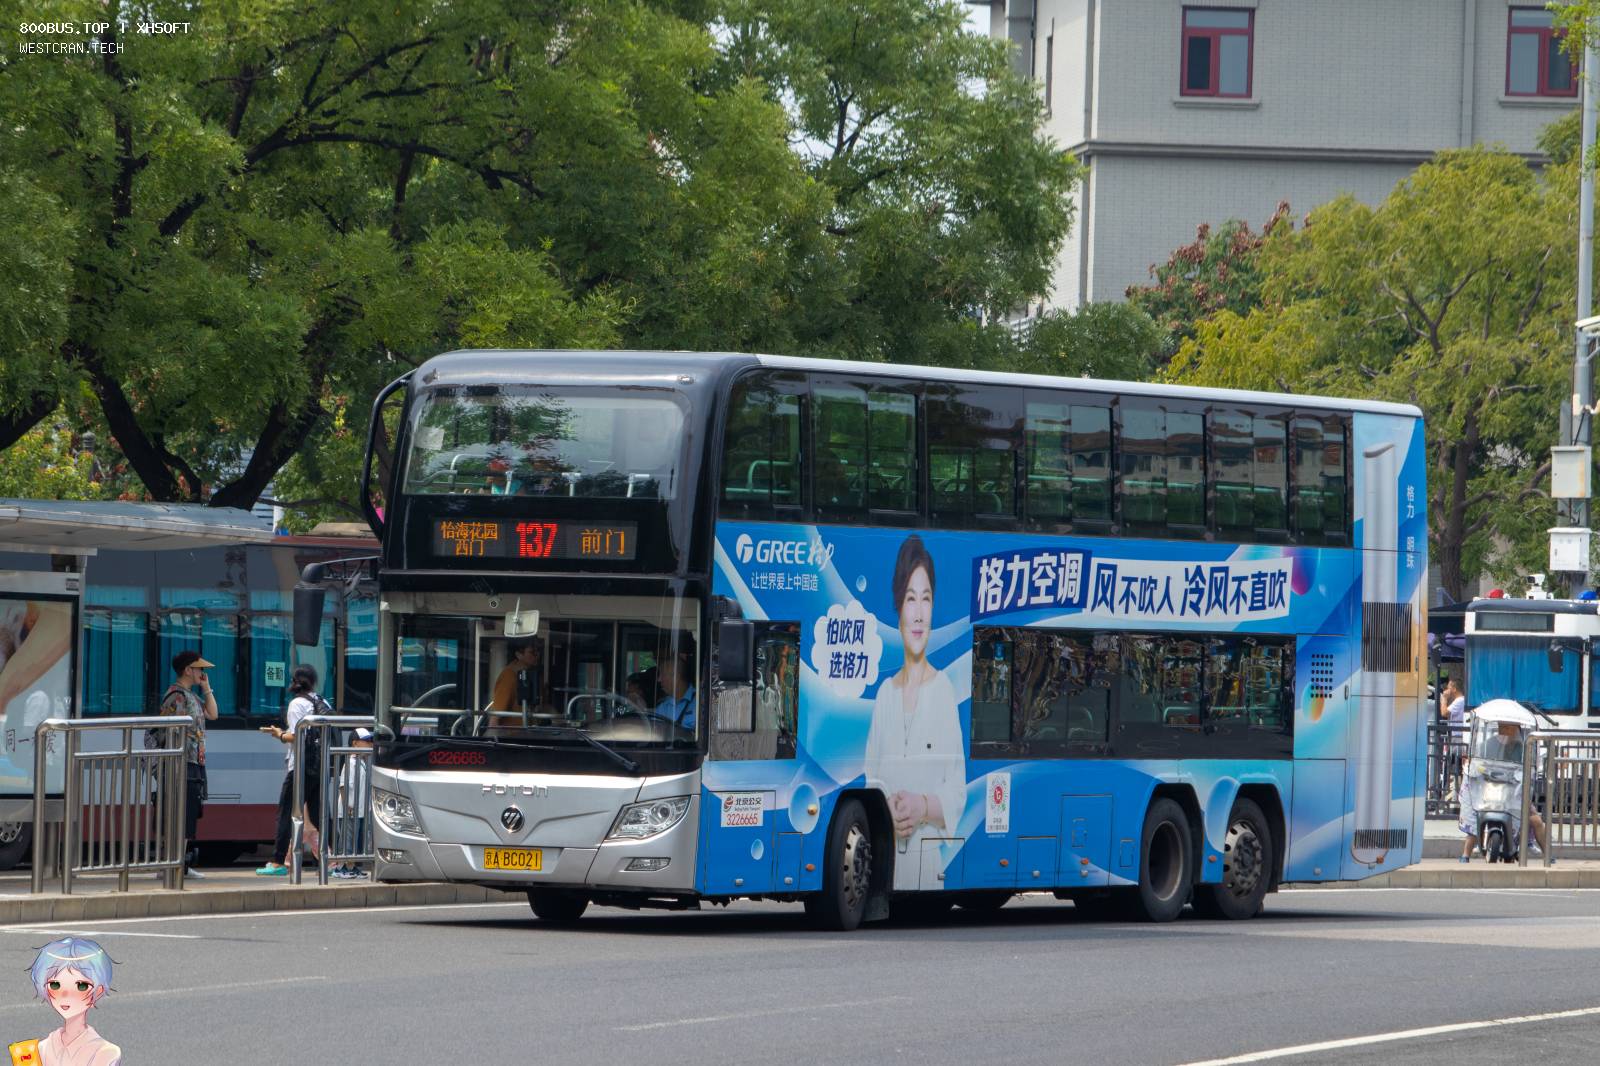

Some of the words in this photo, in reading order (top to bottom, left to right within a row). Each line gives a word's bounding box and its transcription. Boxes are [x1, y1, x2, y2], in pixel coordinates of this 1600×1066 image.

[440, 521, 498, 540] 怡海花园
[515, 522, 558, 558] 137
[581, 528, 625, 555] 前门
[455, 539, 485, 556] 西门
[756, 540, 807, 565] GREE
[751, 571, 819, 592] 让世界爱上中国造
[978, 552, 1084, 614] 格力空调
[1091, 562, 1174, 616] 风不吹人
[1180, 564, 1288, 618] 冷风不直吹
[826, 618, 866, 646] 怕吹风
[829, 651, 869, 679] 选格力
[726, 813, 759, 825] 3226665
